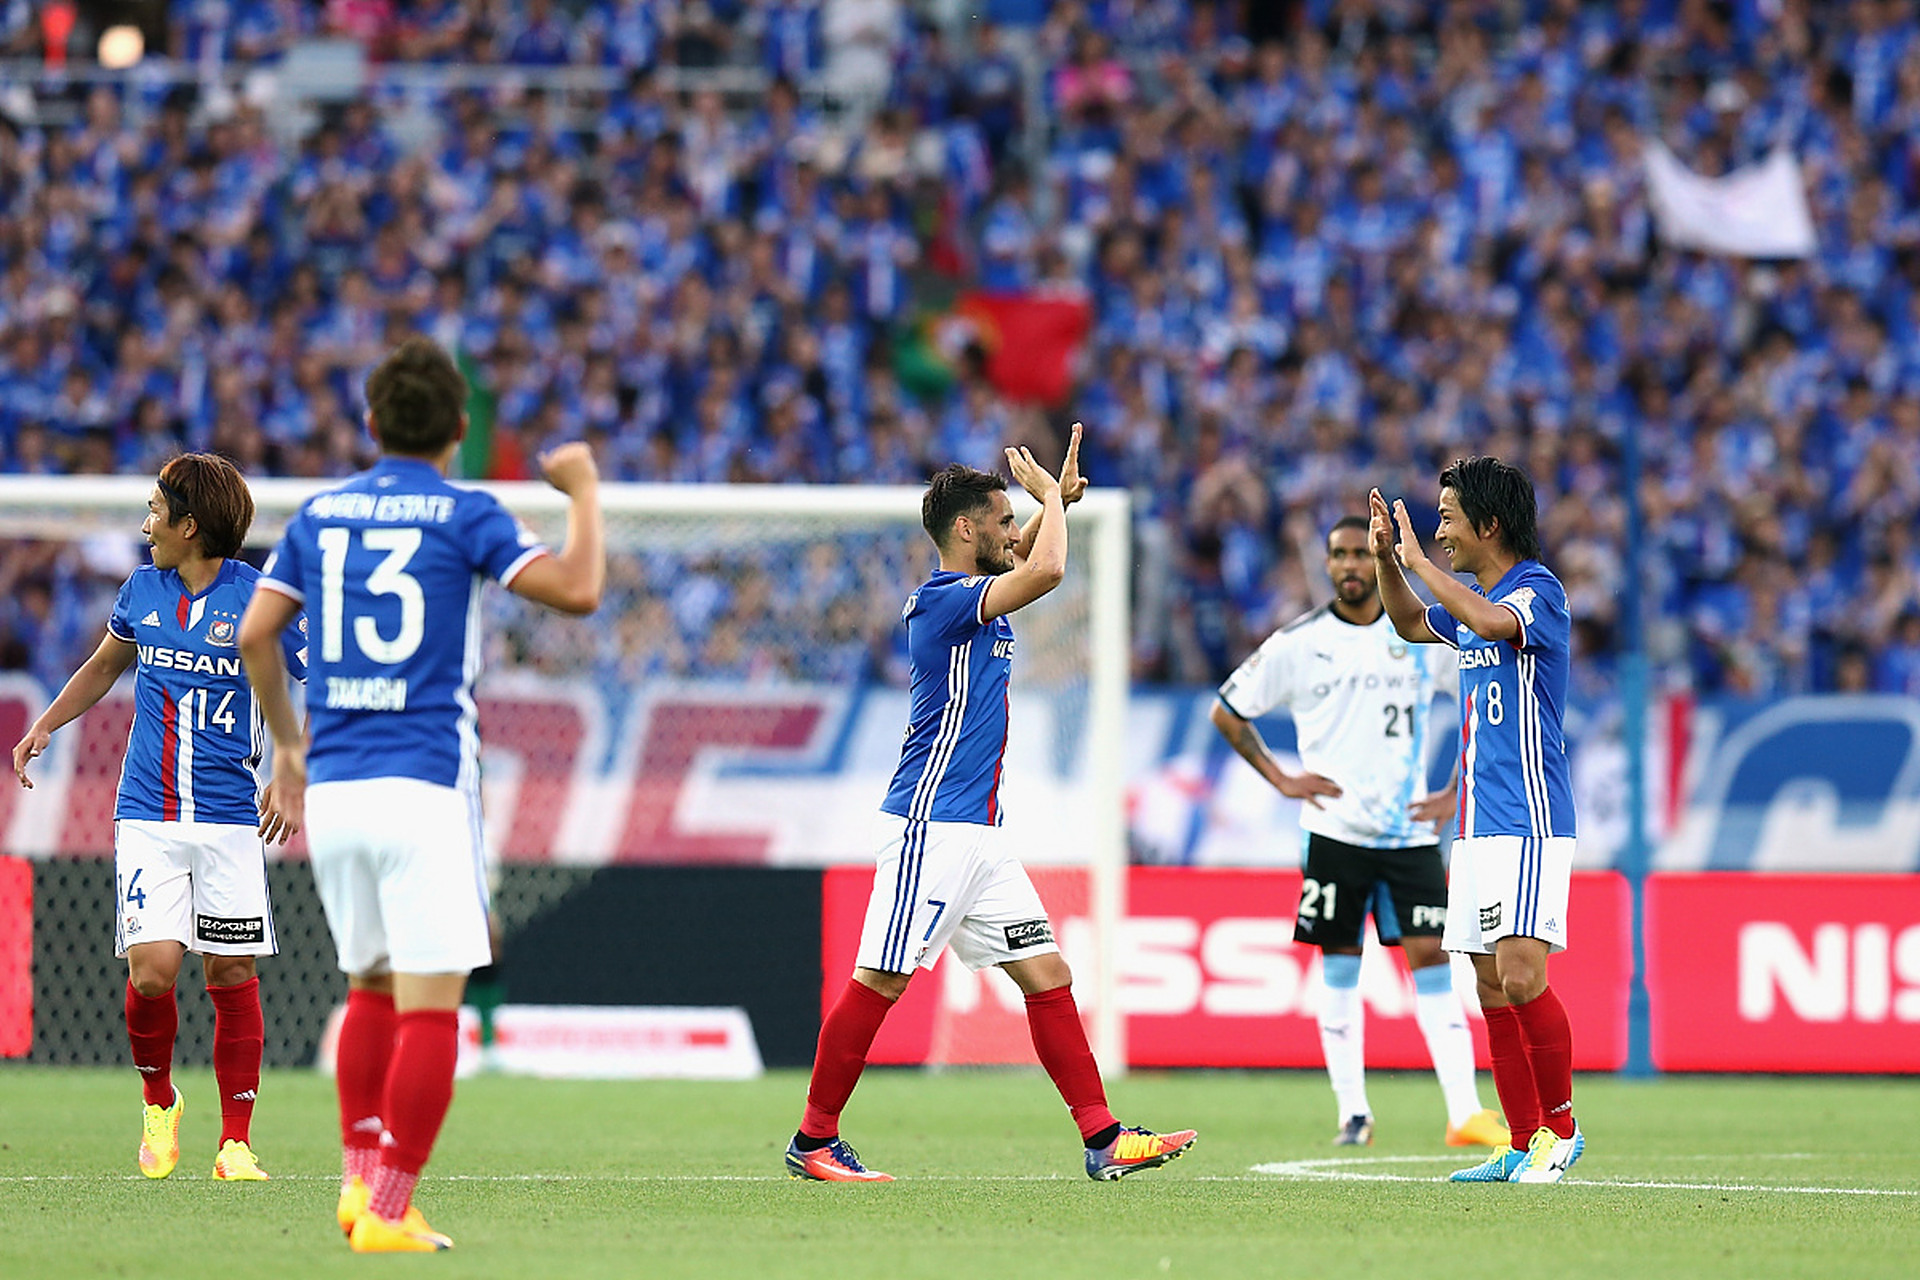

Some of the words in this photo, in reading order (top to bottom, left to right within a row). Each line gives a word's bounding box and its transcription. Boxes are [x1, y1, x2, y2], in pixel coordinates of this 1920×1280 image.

[317, 526, 426, 665] 13
[136, 643, 241, 677] NISSAN
[196, 687, 237, 735] 14
[1383, 704, 1415, 738] 21
[1487, 680, 1505, 726] 8
[923, 899, 946, 941] 7
[1299, 878, 1337, 921] 21
